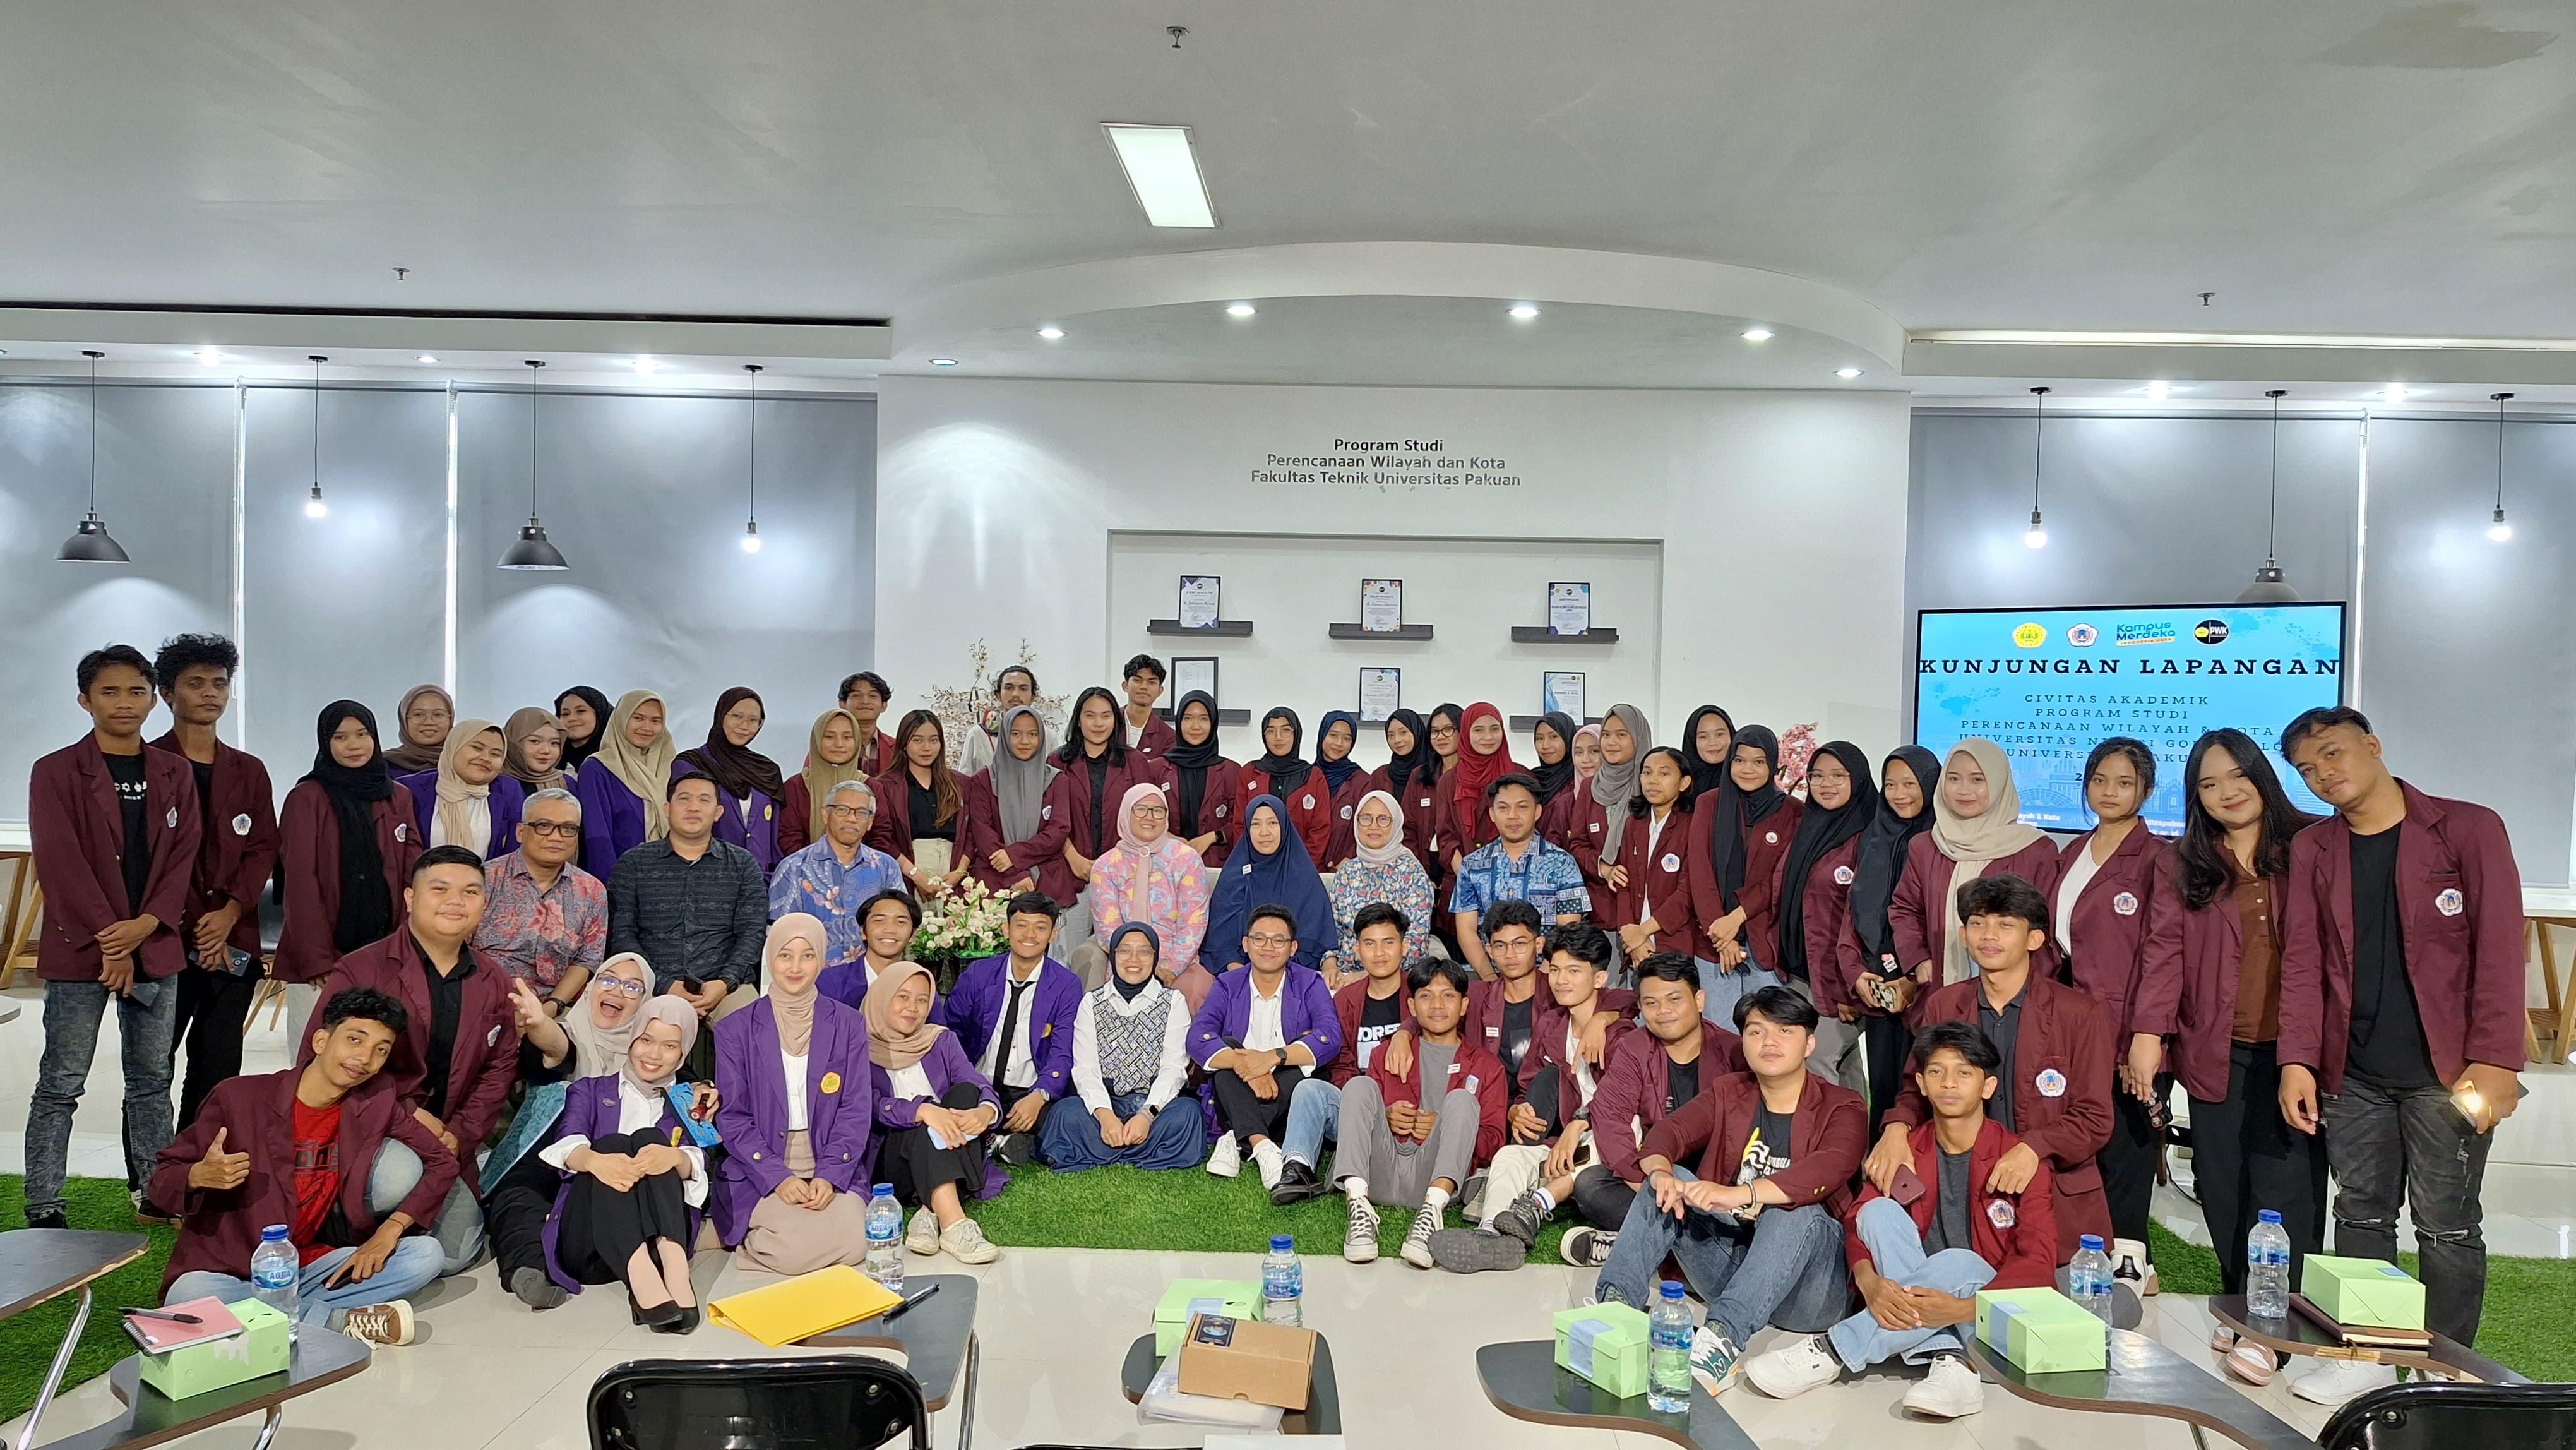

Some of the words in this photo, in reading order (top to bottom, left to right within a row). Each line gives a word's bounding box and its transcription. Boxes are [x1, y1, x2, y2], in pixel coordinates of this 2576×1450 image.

[1334, 438, 1399, 452] Program
[1404, 439, 1443, 452] Studi
[1267, 454, 1364, 467] Perencanaan
[1370, 455, 1431, 471] Wilayah
[1437, 457, 1464, 469] dan
[1470, 457, 1505, 469] Kota
[1251, 470, 1315, 484] Fakultas
[1320, 472, 1369, 484] Teknik
[1374, 473, 1459, 486] Universitas
[1465, 474, 1521, 486] Pakuan
[2116, 622, 2171, 632] Kampus
[2210, 626, 2227, 635] PWK
[2116, 630, 2176, 641] Merdeka
[1920, 659, 2120, 674] KUNJUNGAN
[2139, 659, 2339, 674] LAPANGAN
[2025, 695, 2097, 704] CIVITAS
[2108, 695, 2209, 705] AKADEMIK
[2036, 708, 2121, 717] PROGRAM
[2132, 710, 2188, 719] STUDI
[1962, 721, 2090, 731] PERENCANAAN
[2102, 724, 2189, 733] WILAYAH
[2237, 726, 2274, 736] OTA
[1959, 734, 2077, 745] UVERSITAS
[2007, 749, 2084, 759] UNIVERS
[269, 1270, 291, 1280] AQUA
